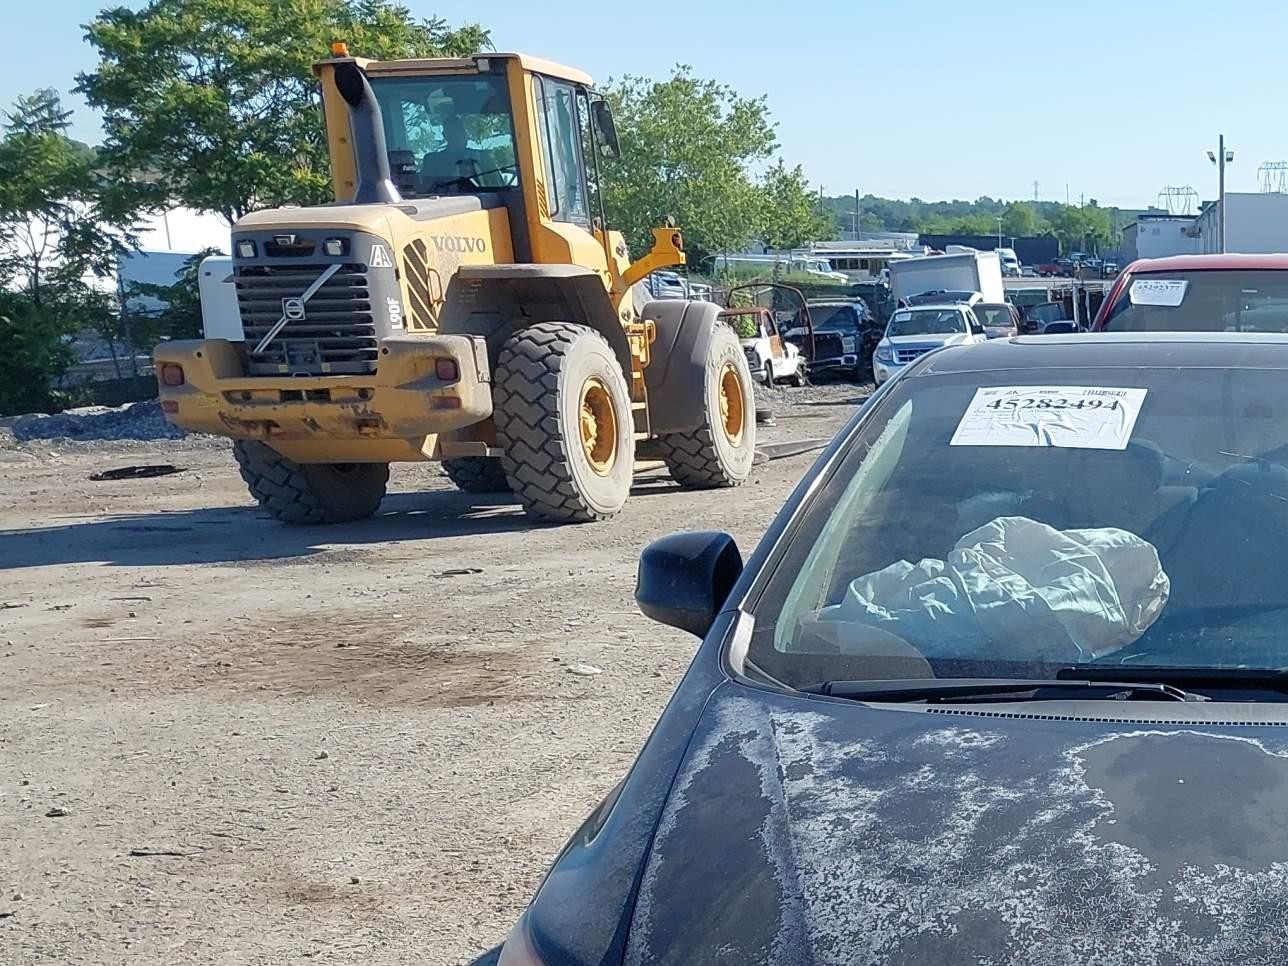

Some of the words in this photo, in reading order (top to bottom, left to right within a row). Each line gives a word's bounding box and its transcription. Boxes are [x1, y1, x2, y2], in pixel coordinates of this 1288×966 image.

[430, 235, 487, 254] VOLVO
[387, 296, 404, 330] L90F
[986, 398, 1120, 411] 45282494
